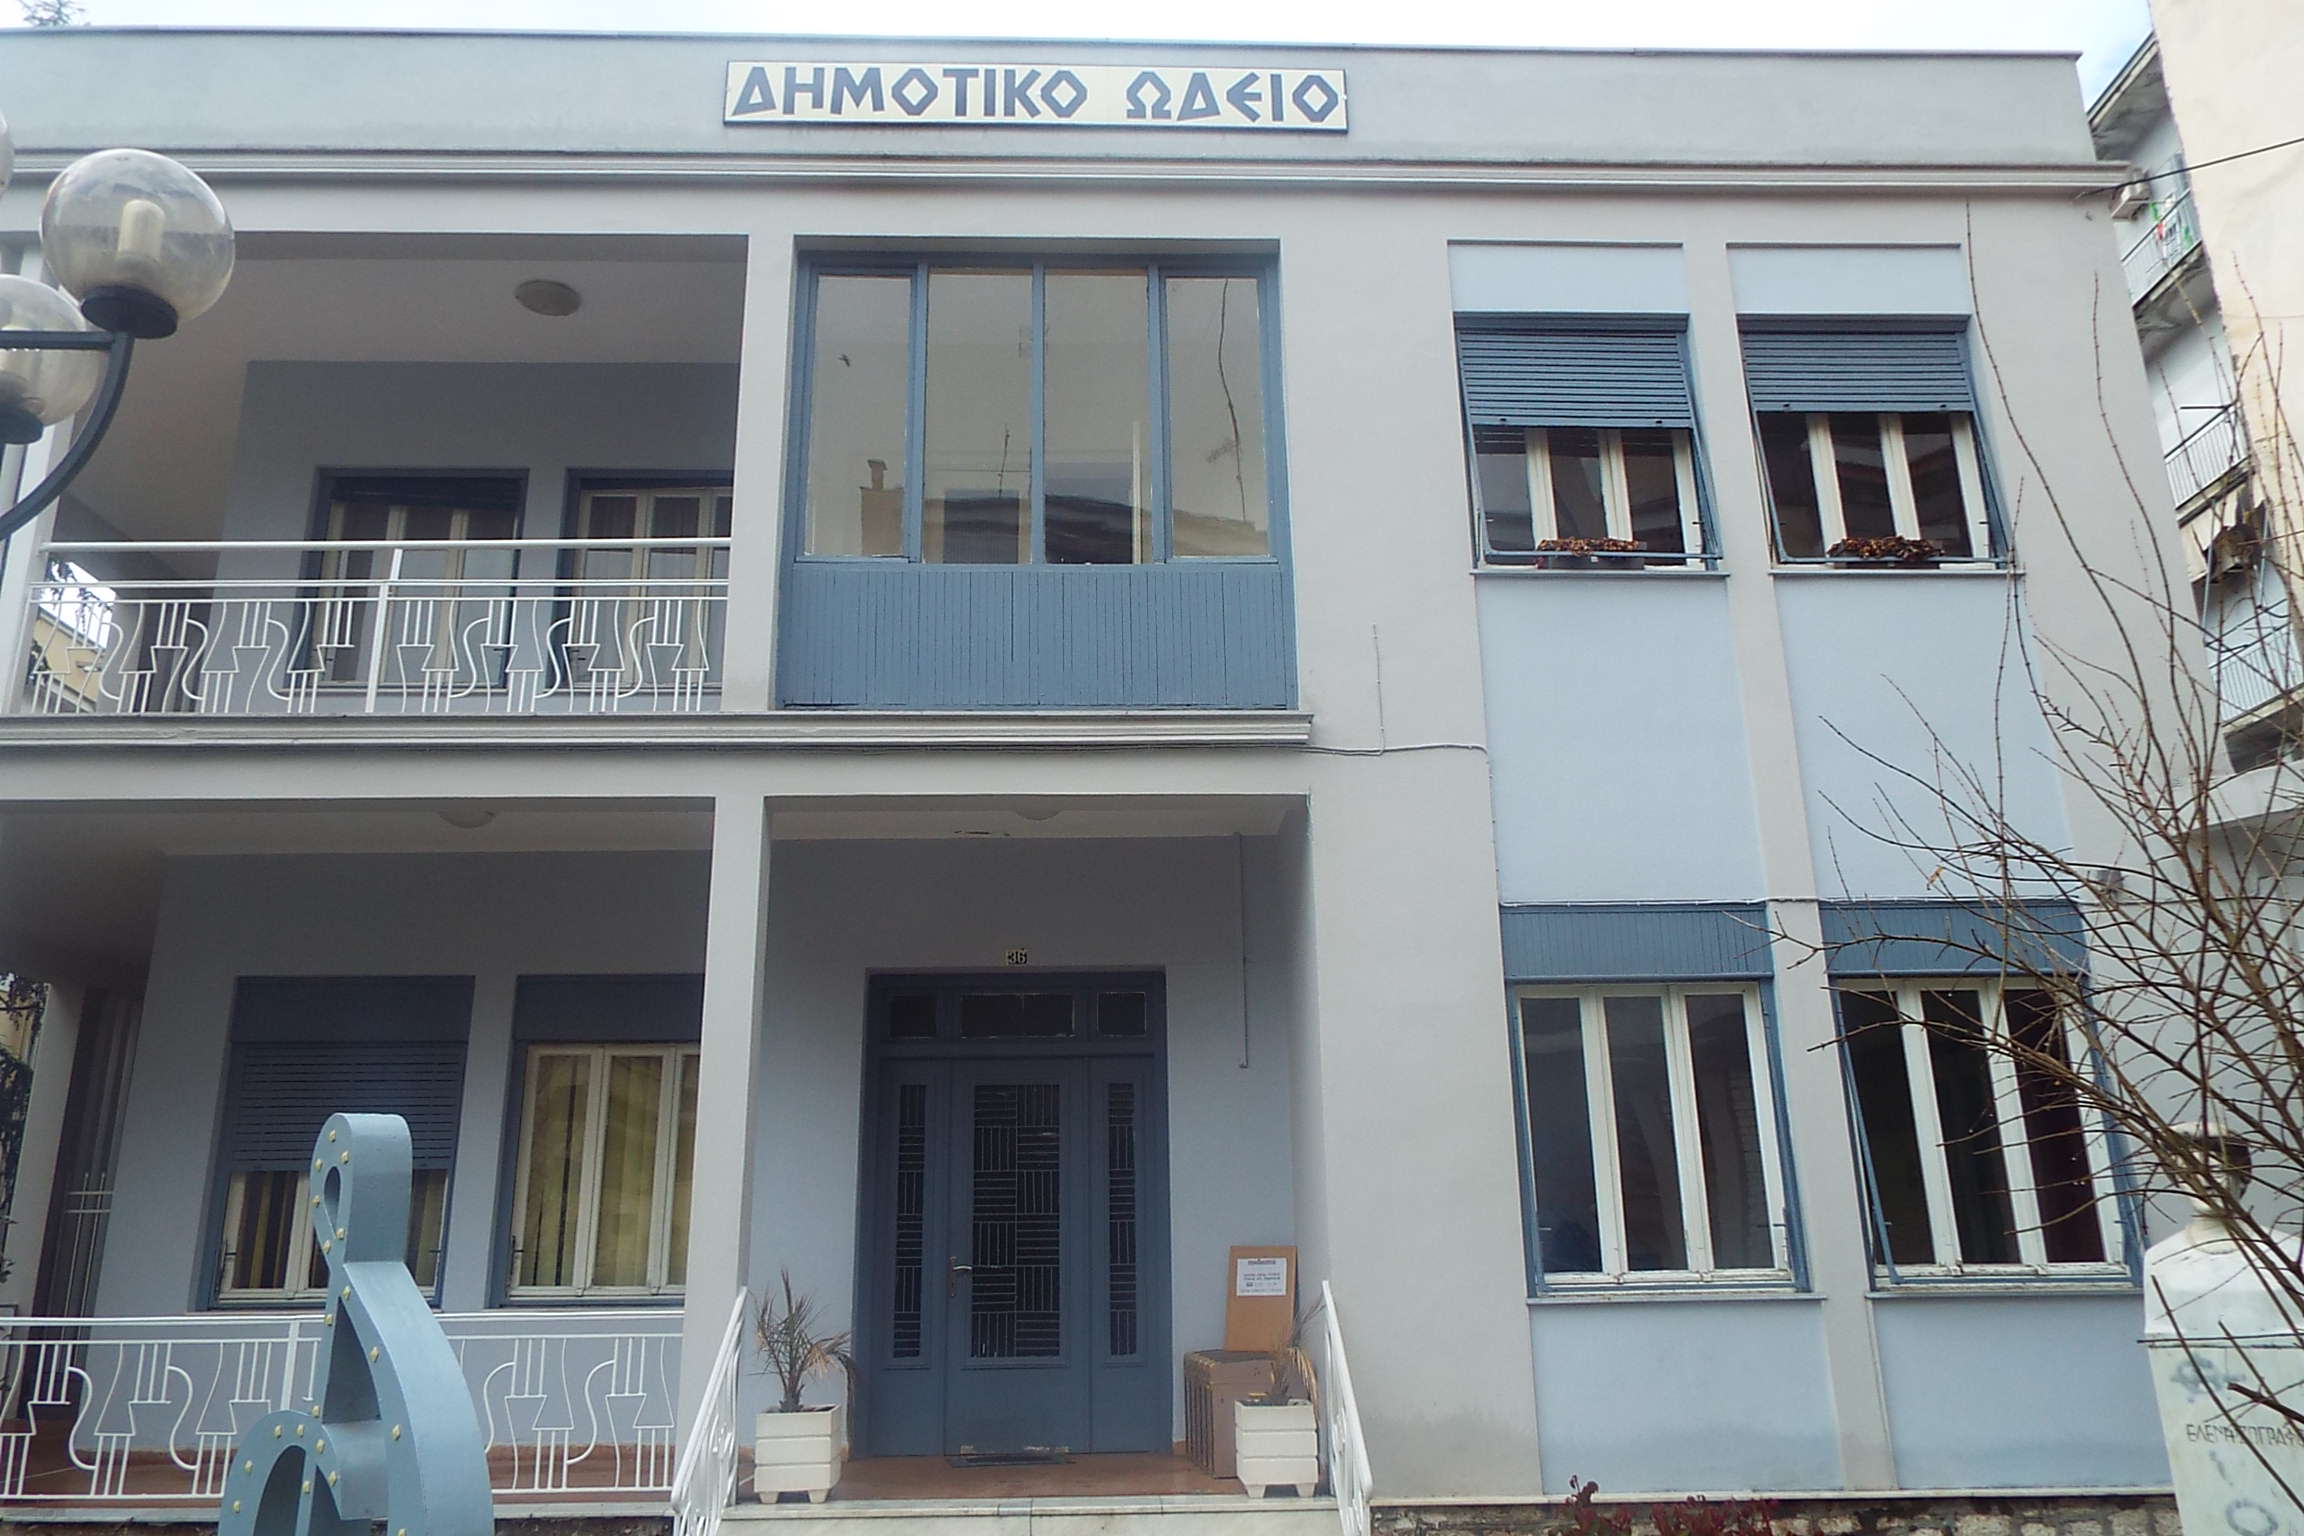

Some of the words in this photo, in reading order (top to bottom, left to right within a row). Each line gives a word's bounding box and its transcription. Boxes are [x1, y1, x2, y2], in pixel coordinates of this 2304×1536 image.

[731, 66, 1087, 119] ΔΗΜΟΤΙΚΟ
[1126, 70, 1339, 122] ΩΔΕΙΟ
[1008, 951, 1026, 965] 36
